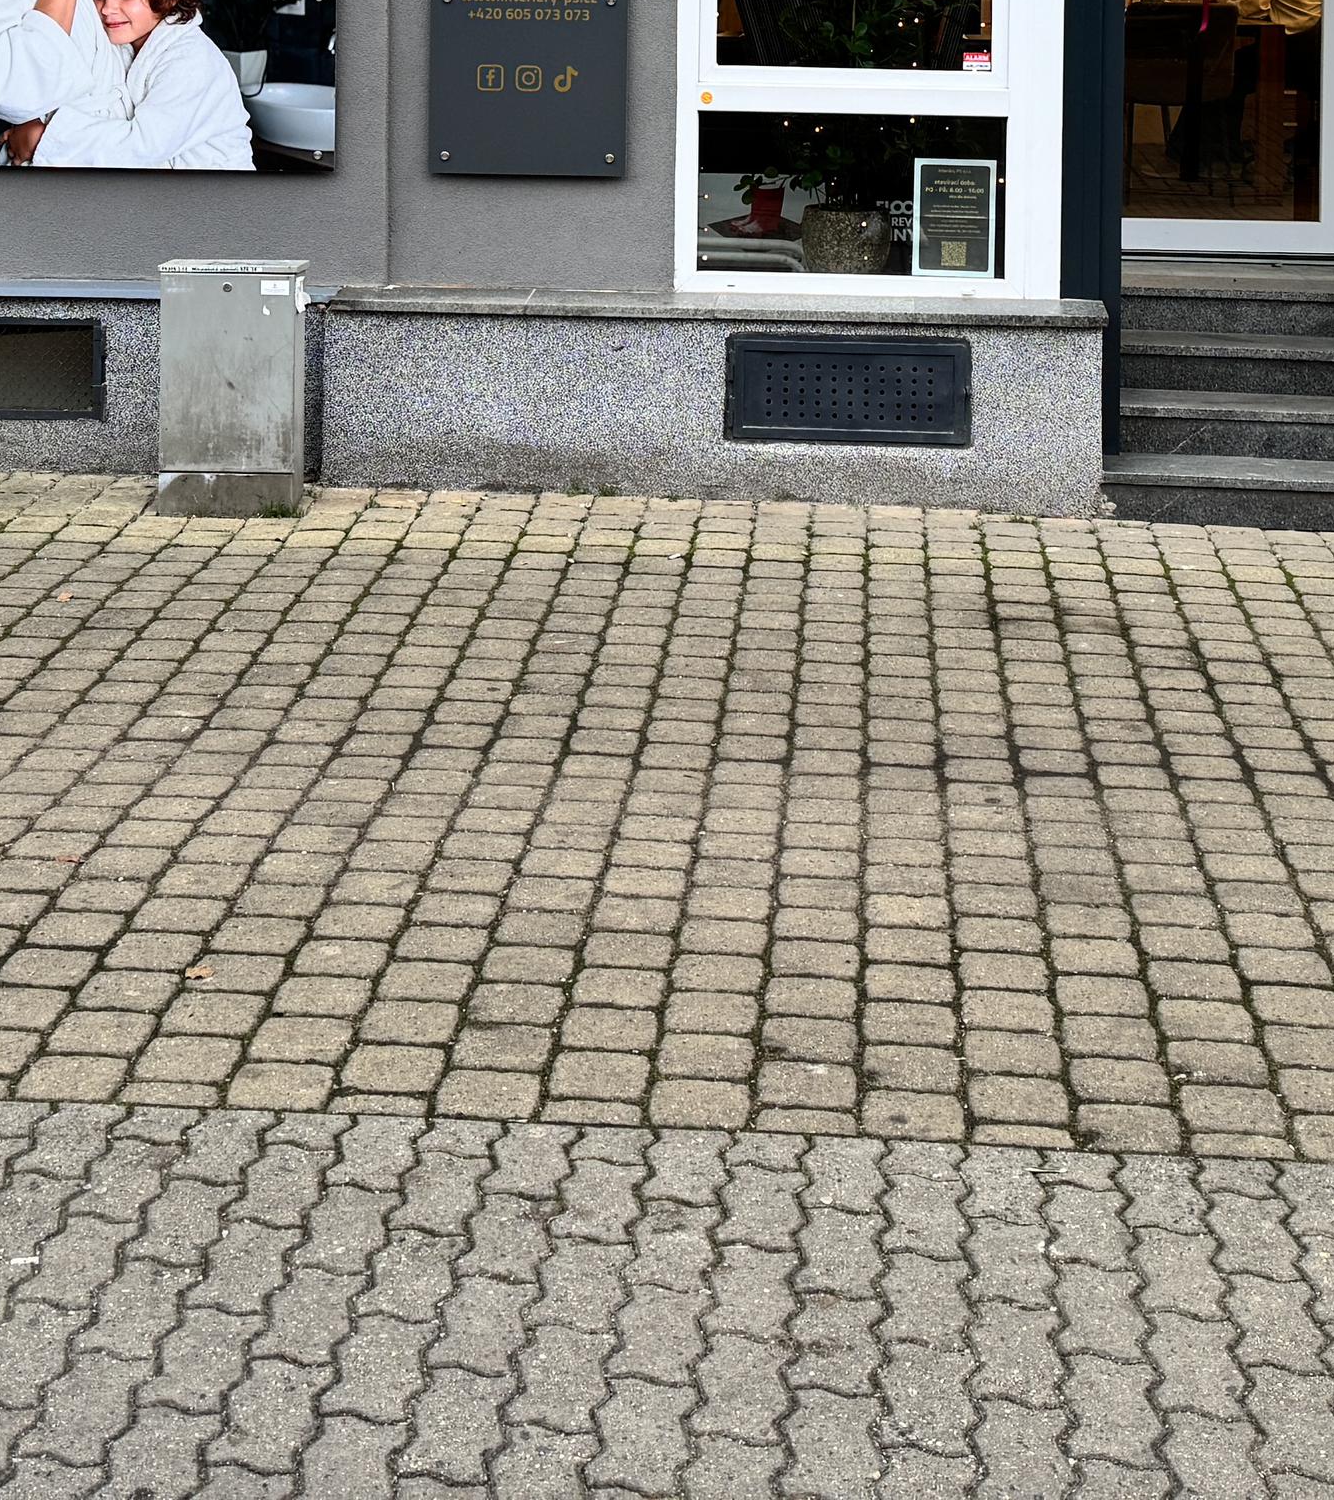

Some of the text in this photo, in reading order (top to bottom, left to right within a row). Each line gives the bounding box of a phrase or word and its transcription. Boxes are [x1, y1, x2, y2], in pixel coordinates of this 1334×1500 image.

[467, 7, 591, 22] +420 605 073 073
